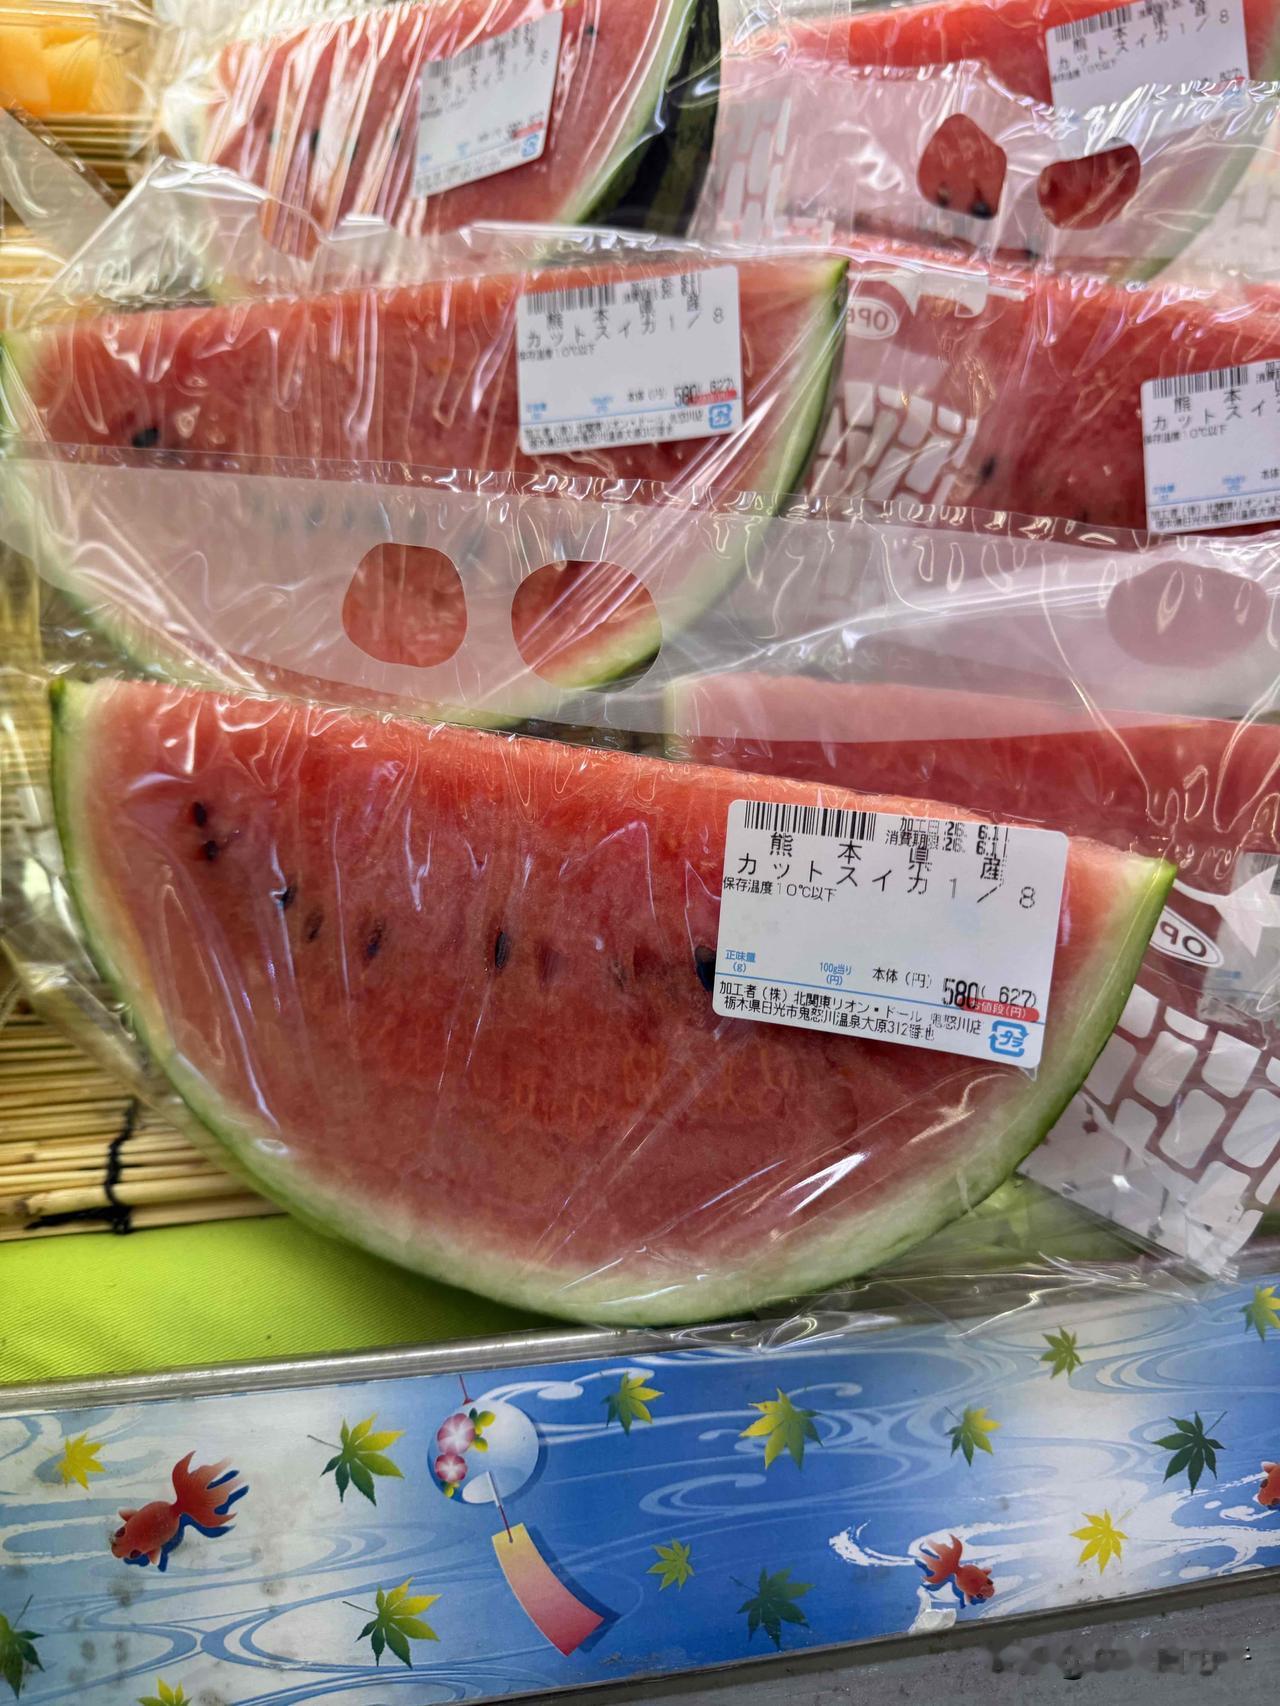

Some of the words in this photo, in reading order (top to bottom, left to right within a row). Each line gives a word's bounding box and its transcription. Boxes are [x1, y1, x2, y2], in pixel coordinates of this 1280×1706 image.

[1153, 399, 1280, 431] カットスイ
[725, 950, 756, 963] 正味量
